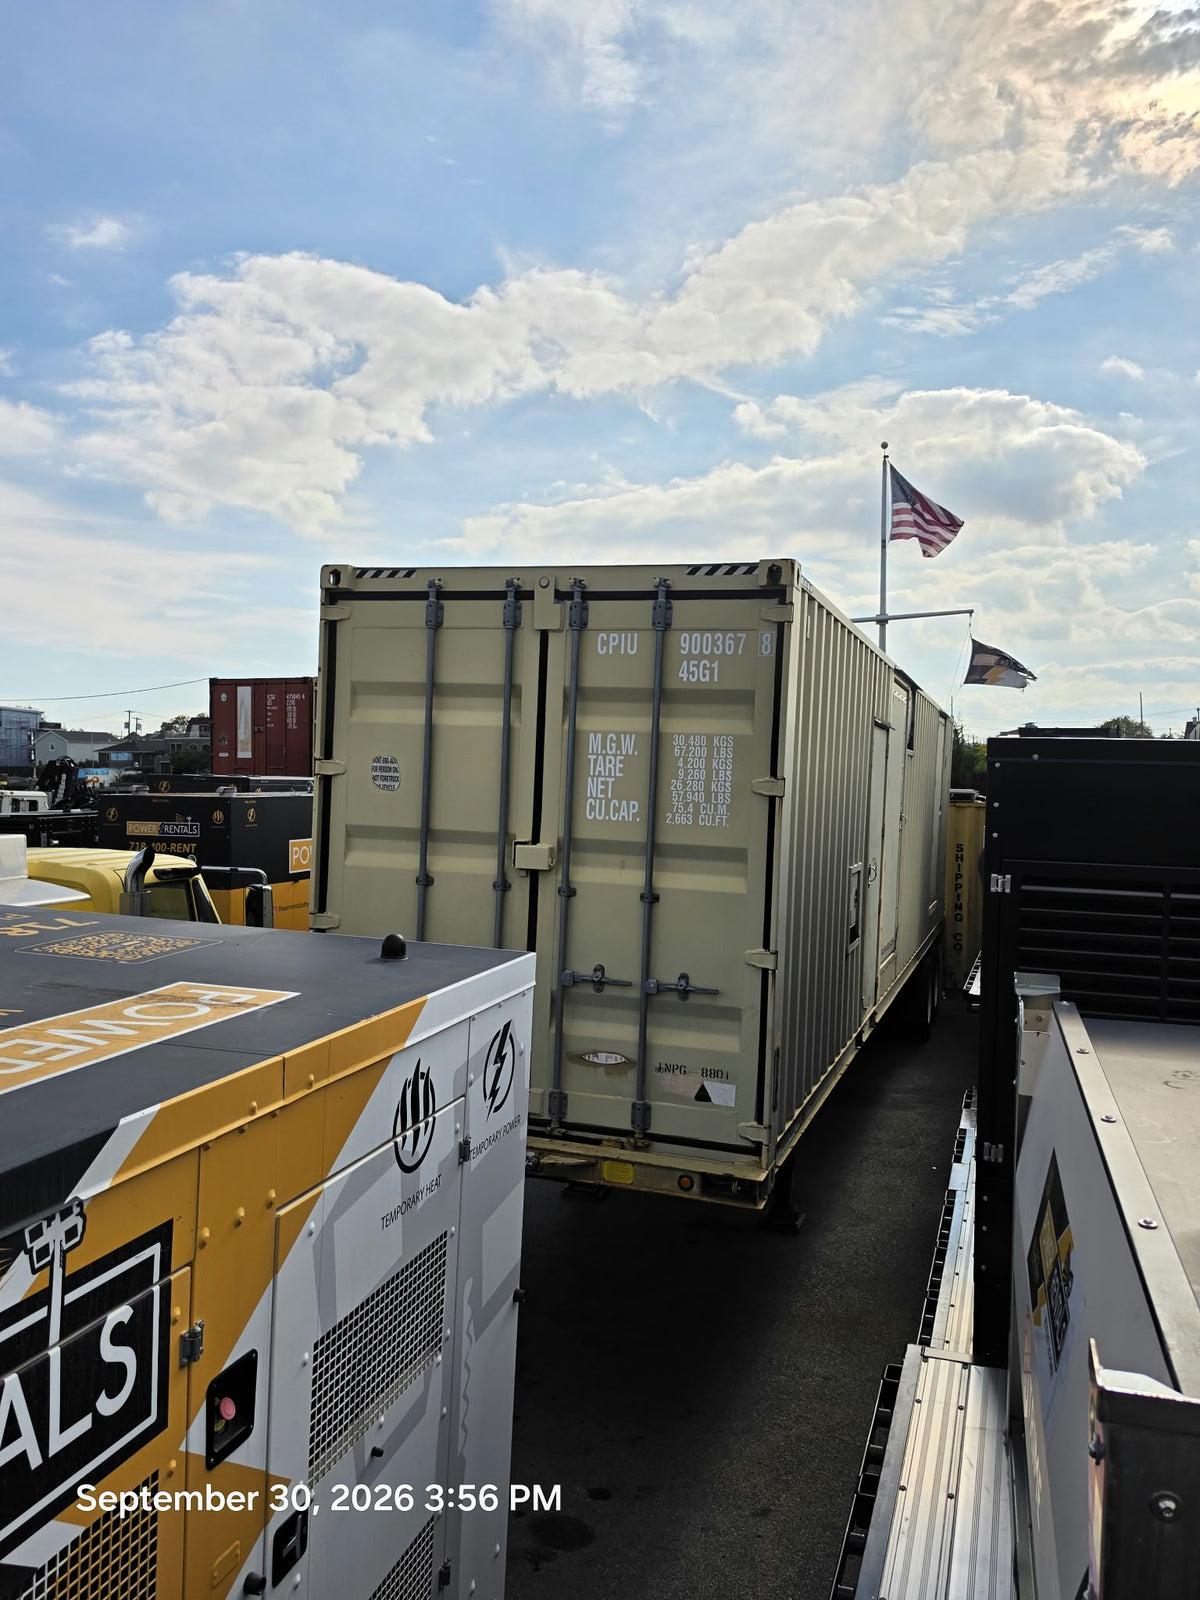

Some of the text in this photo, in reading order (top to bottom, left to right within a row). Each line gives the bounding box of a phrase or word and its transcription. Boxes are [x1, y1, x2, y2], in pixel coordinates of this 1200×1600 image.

[597, 632, 772, 656] CPIU 900367 8
[678, 660, 720, 682] 45G1
[589, 732, 638, 755] M.G.W.
[714, 736, 734, 747] KGS
[714, 747, 733, 758] LBS
[588, 756, 624, 776] TARE
[712, 758, 732, 770] KGS
[713, 770, 732, 781] LBS
[587, 777, 615, 798] NET
[711, 781, 731, 792] KGS
[711, 793, 731, 804] LBS
[586, 799, 640, 822] CU.CAP.
[672, 802, 730, 816] 75.4 CU.M.
[128, 824, 197, 834] POWER RENTALS
[699, 815, 729, 827] CU.FT.
[292, 846, 312, 866] PO
[954, 844, 964, 922] SHIPPING
[469, 1114, 520, 1161] TEMPORARY POWER
[381, 1174, 442, 1230] TEMPORARY HEAT
